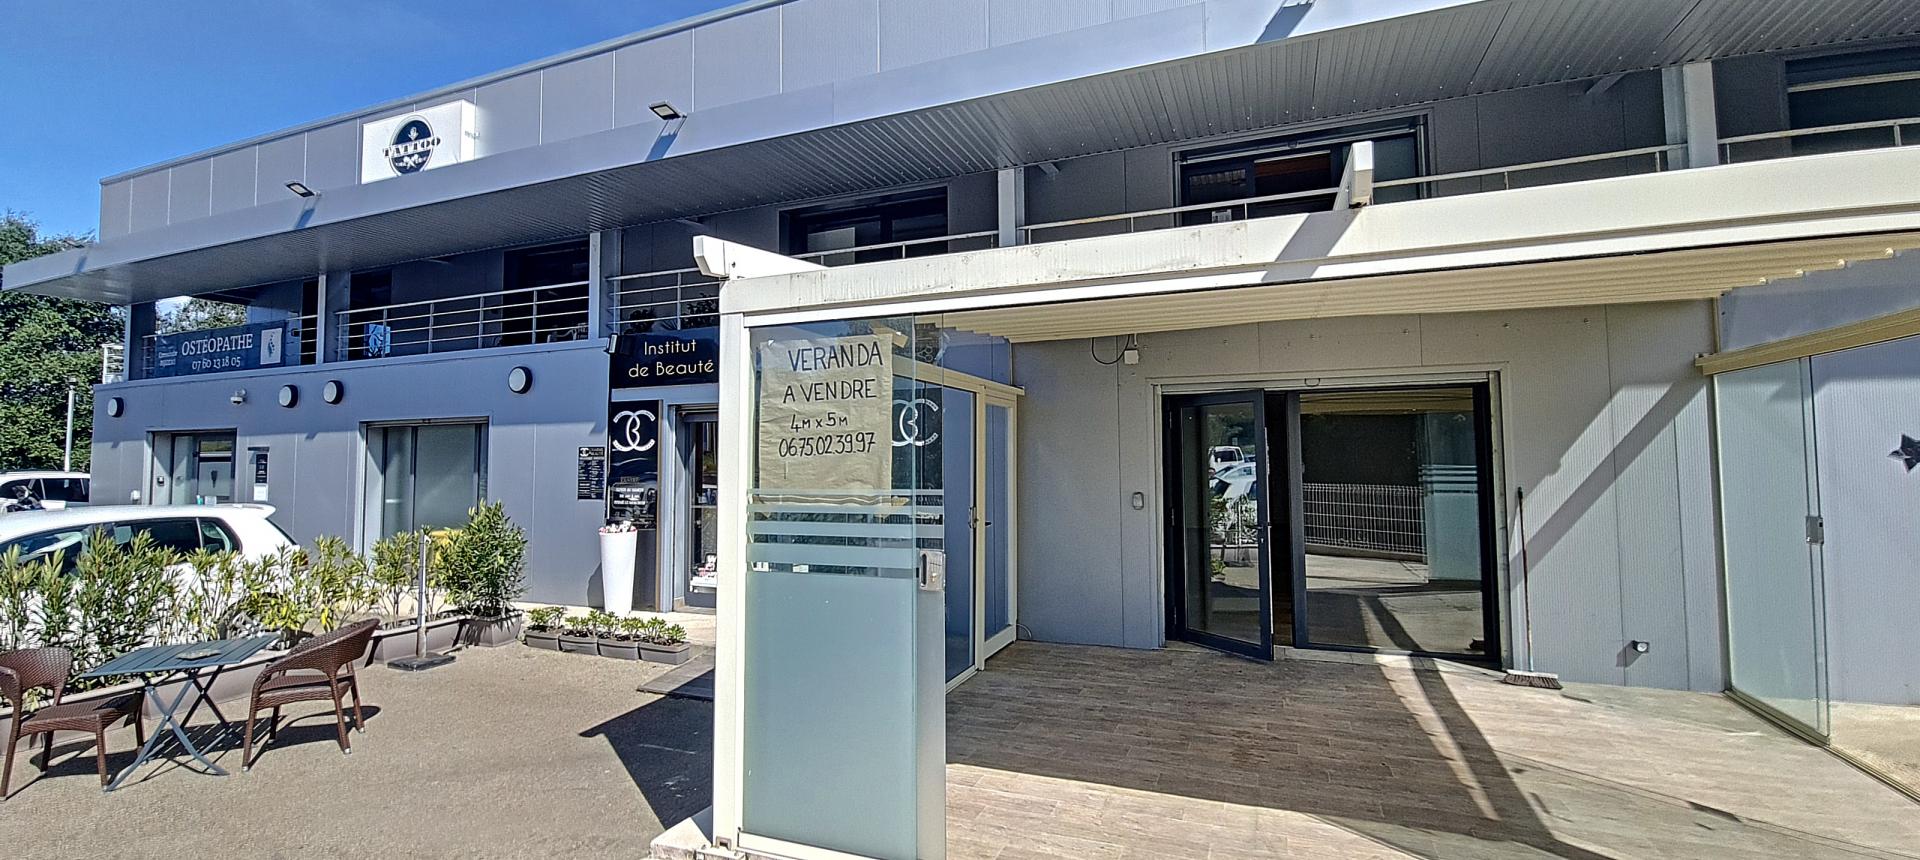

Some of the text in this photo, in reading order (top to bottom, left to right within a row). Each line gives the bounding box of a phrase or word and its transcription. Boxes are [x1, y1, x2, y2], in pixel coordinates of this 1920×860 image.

[181, 334, 253, 356] OSTÉOPATHE
[644, 339, 697, 356] Institut
[192, 360, 201, 371] 07
[202, 358, 211, 369] 60
[213, 358, 221, 369] 13
[231, 356, 241, 368] 05
[788, 341, 884, 372] VERANDA
[628, 359, 714, 378] de Beauté
[783, 379, 877, 404] A VENDRE
